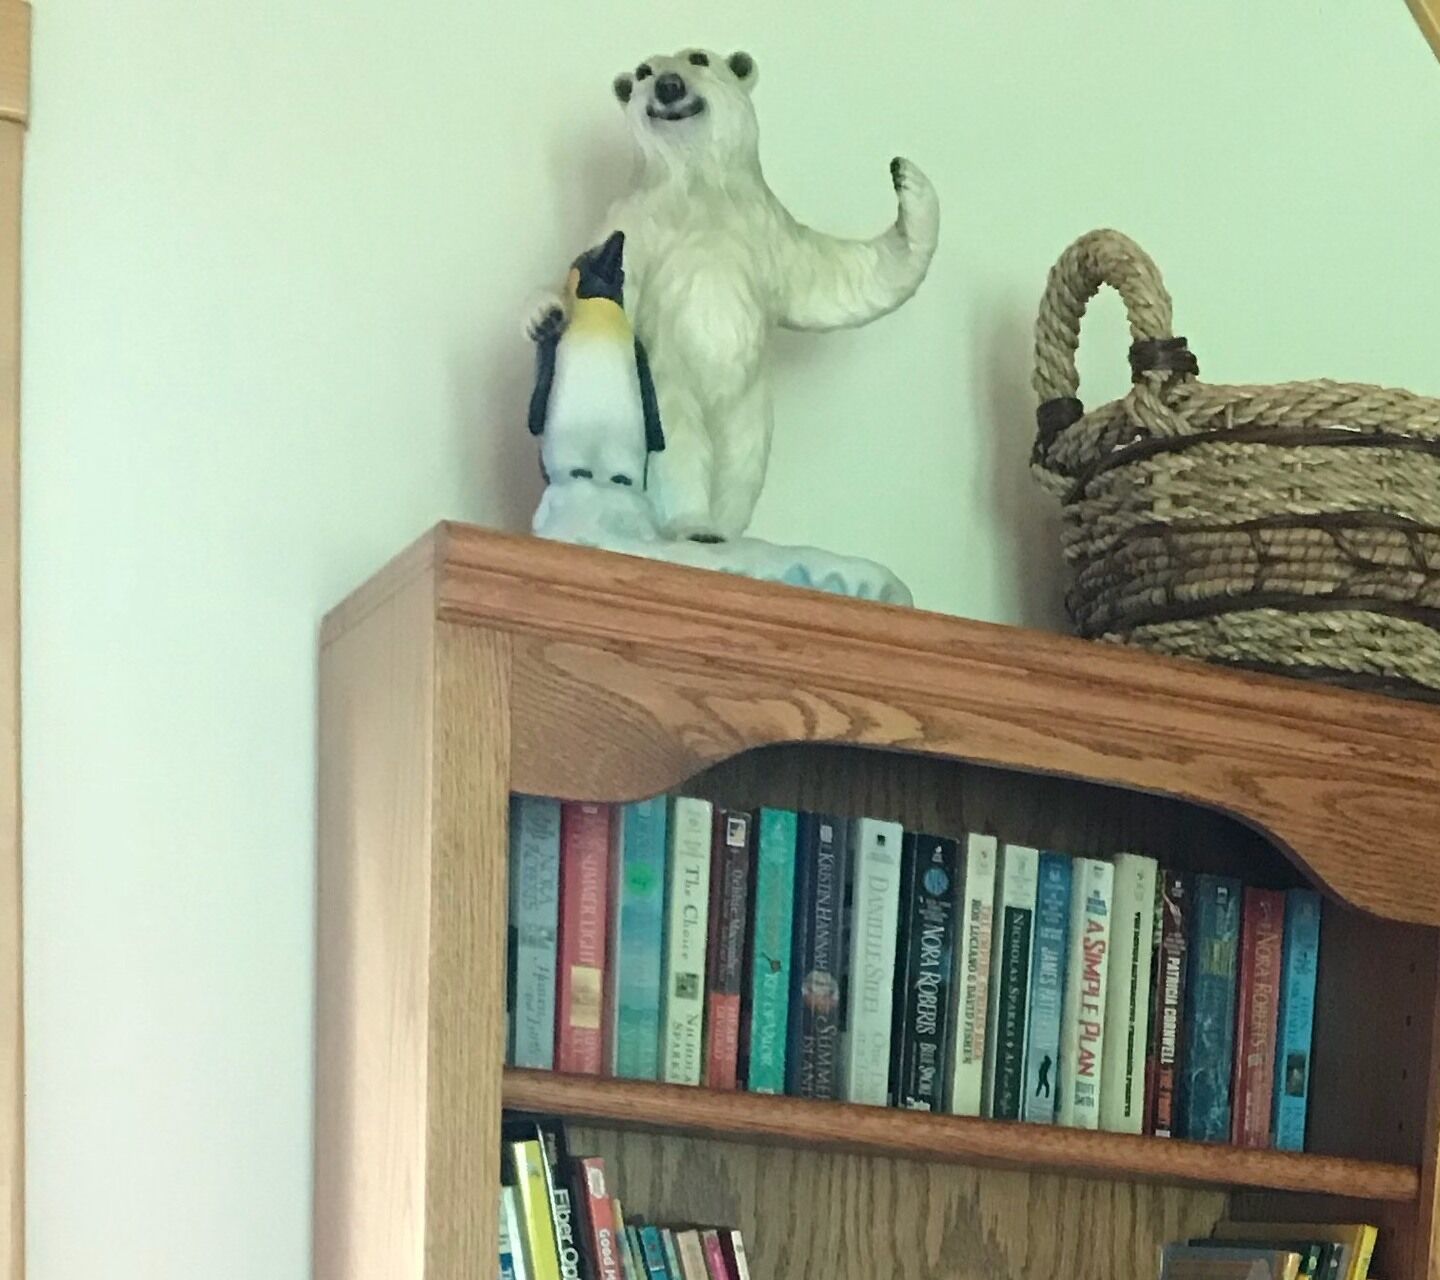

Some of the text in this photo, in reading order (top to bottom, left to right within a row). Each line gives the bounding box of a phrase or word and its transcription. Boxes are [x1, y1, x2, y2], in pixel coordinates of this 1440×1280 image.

[680, 864, 701, 961] The Choice
[813, 853, 834, 970] KRISTIN HANNAH
[865, 874, 888, 961] DANIELLE
[1255, 931, 1279, 977] NORA
[914, 922, 945, 1035] NORA ROBERTS
[1006, 912, 1025, 1037] NICHOLAS SPARKS
[1039, 946, 1060, 985] JAMES
[1077, 918, 1106, 1078] A SIMPLE PLAN
[1159, 956, 1181, 1065] PATRICIA CORNWELL
[1249, 982, 1274, 1047] ROBERTS
[551, 1187, 577, 1247] Fiber
[596, 1227, 616, 1266] Good
